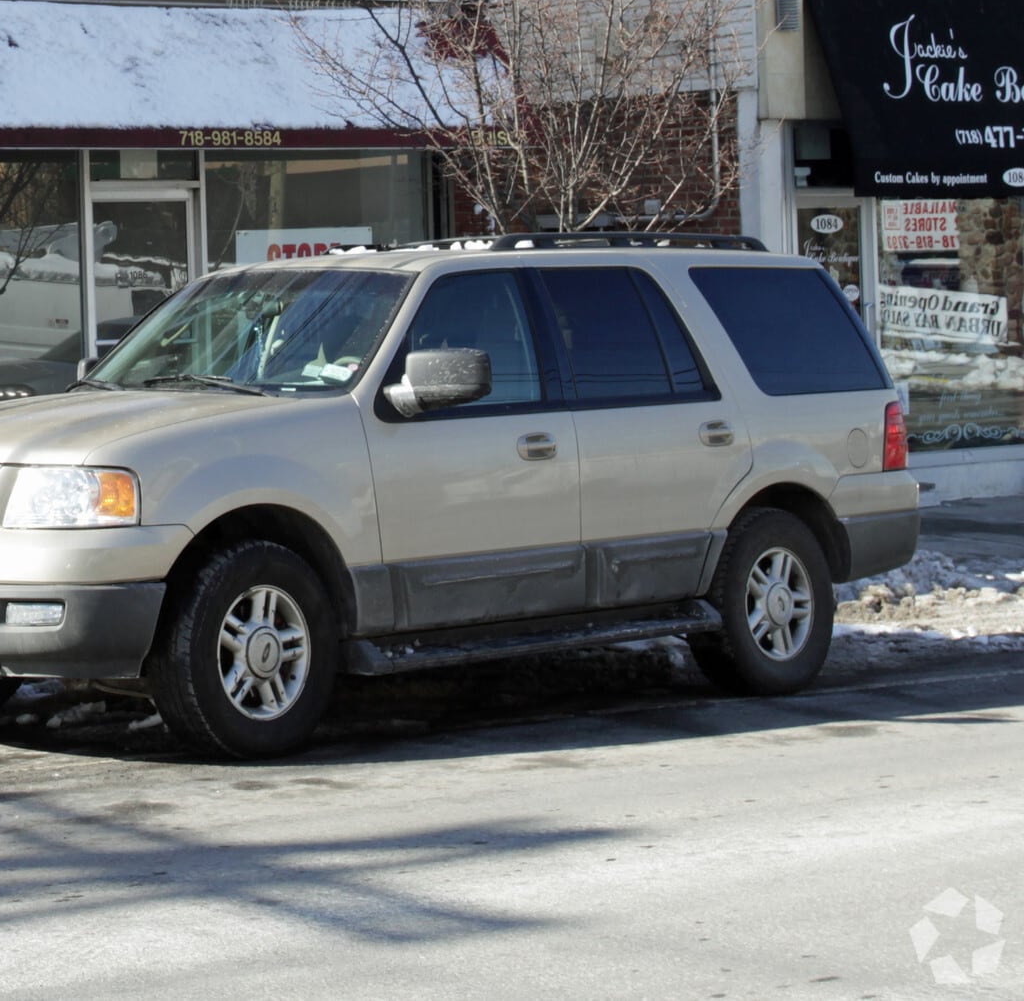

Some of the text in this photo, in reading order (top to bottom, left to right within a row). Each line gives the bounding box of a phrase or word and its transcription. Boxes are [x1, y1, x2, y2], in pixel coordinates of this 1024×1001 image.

[882, 14, 968, 99] Jackie's
[916, 64, 983, 102] Cake
[179, 130, 282, 147] 718-981-8584
[955, 125, 1024, 149] (718) 477-
[875, 170, 988, 186] Custom Cakes by appointment
[1007, 172, 1024, 183] 108
[816, 217, 840, 231] 1084
